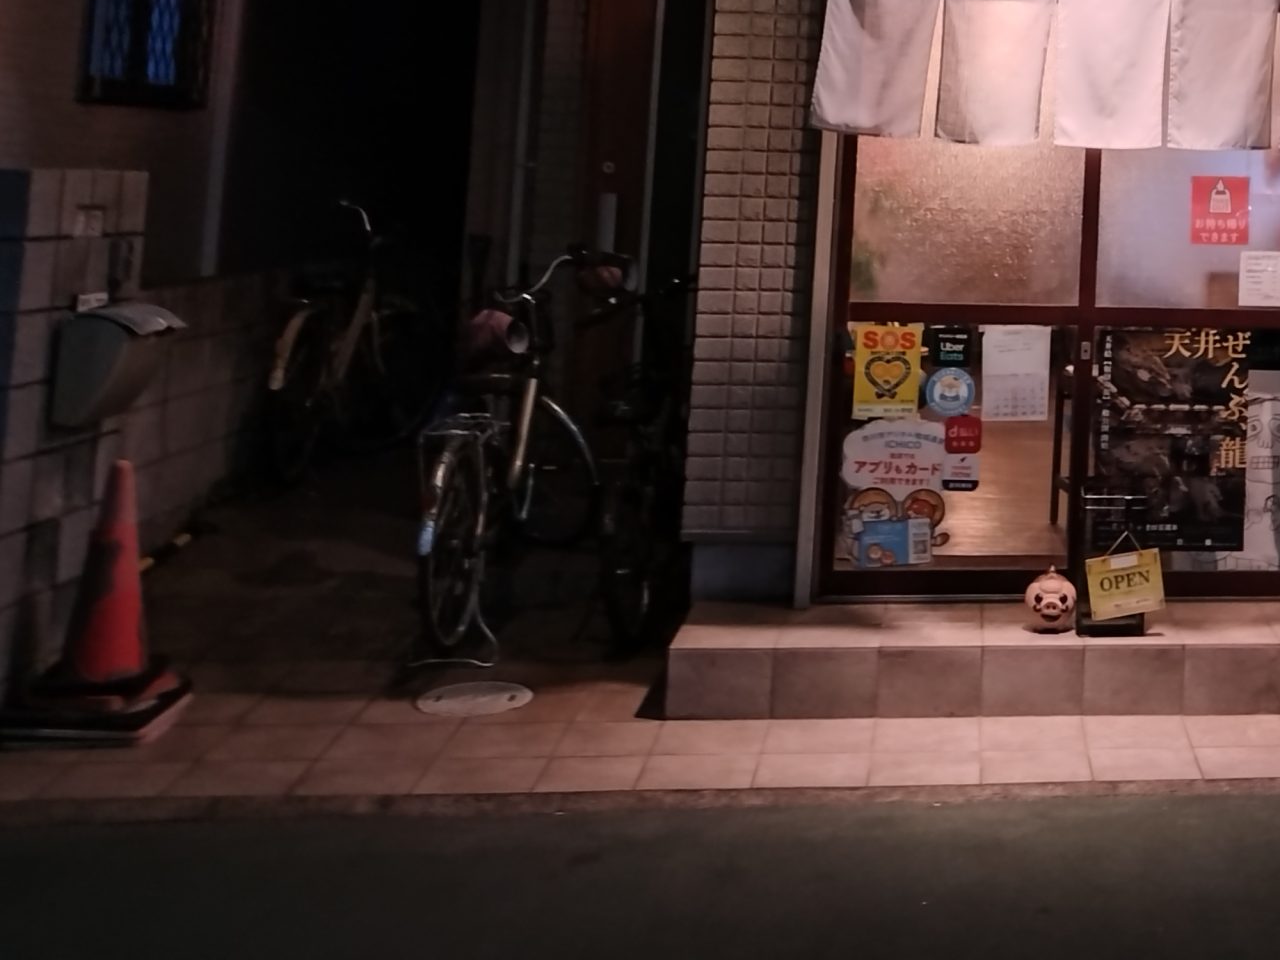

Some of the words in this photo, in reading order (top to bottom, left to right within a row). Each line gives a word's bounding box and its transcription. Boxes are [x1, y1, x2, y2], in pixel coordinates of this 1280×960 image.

[1199, 232, 1240, 243] できます
[863, 330, 916, 350] SOS
[940, 341, 965, 352] Uber
[1100, 570, 1150, 592] OPEN
